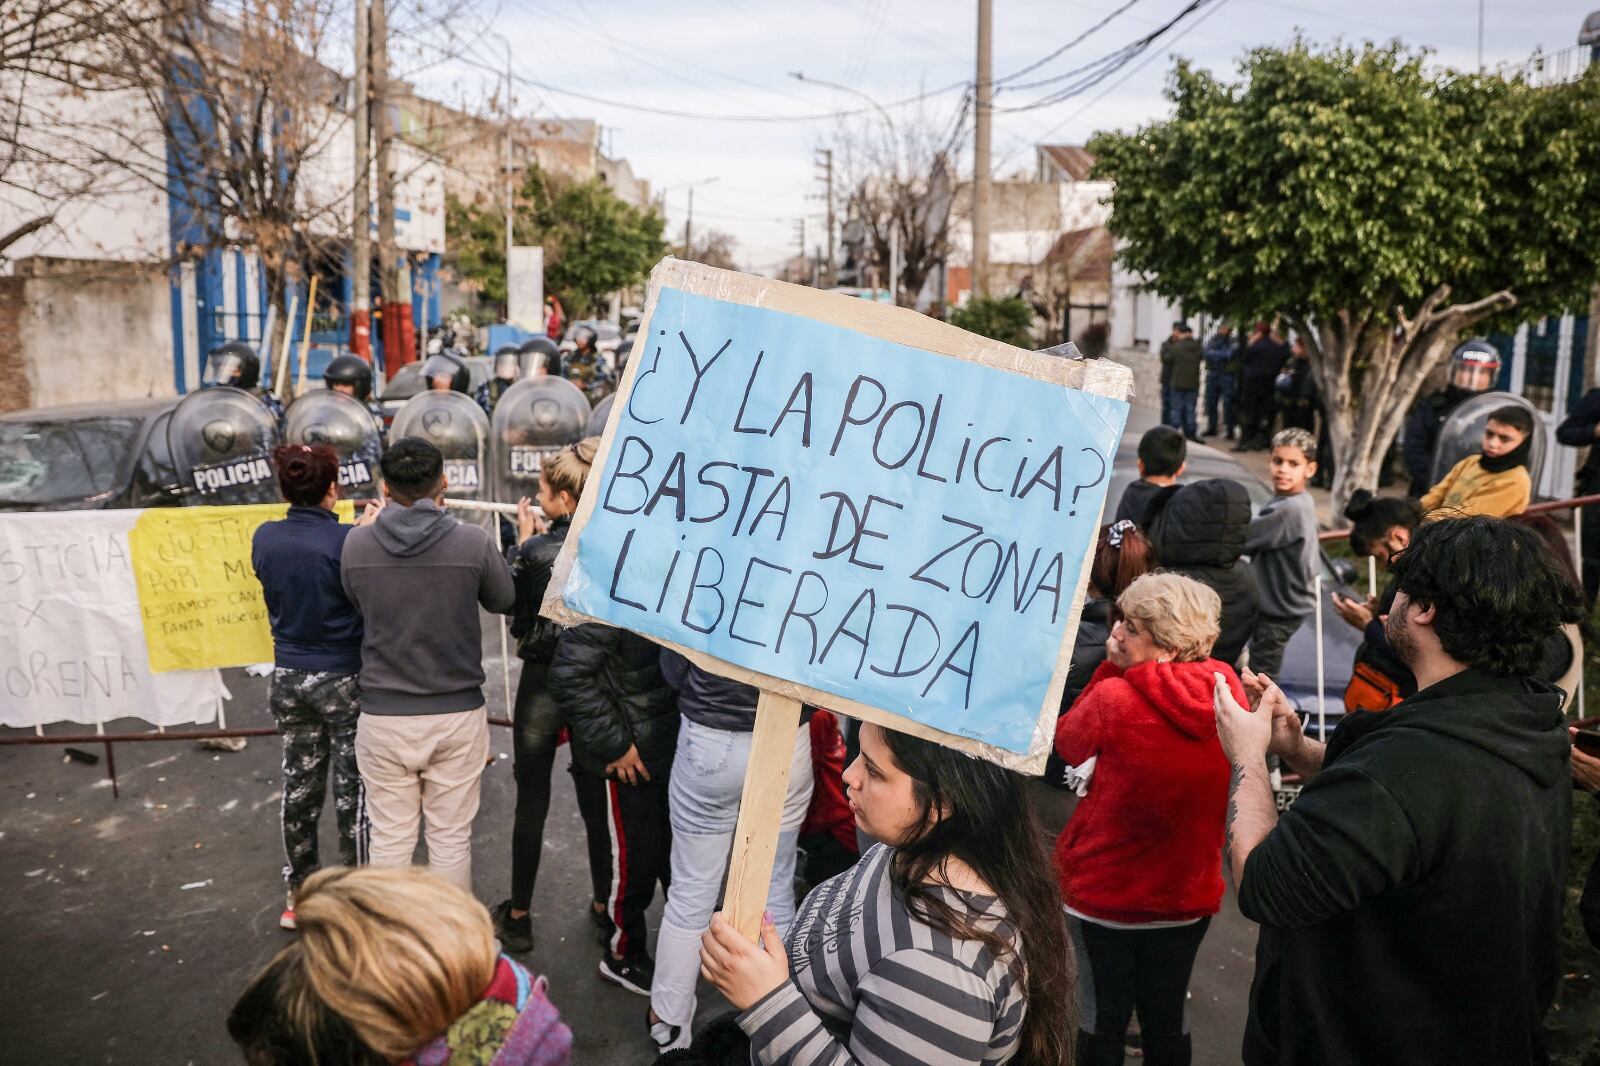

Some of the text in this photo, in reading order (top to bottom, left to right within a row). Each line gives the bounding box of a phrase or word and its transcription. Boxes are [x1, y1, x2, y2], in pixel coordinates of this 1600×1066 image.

[629, 329, 733, 425] ¿Y
[733, 350, 813, 448] LA
[193, 459, 272, 490] POLICIA
[602, 436, 1064, 625] BASTA DE ZONA
[228, 591, 262, 605] CAN
[16, 600, 49, 628] X
[161, 618, 204, 635] TANTA
[5, 650, 139, 699] ORENA
